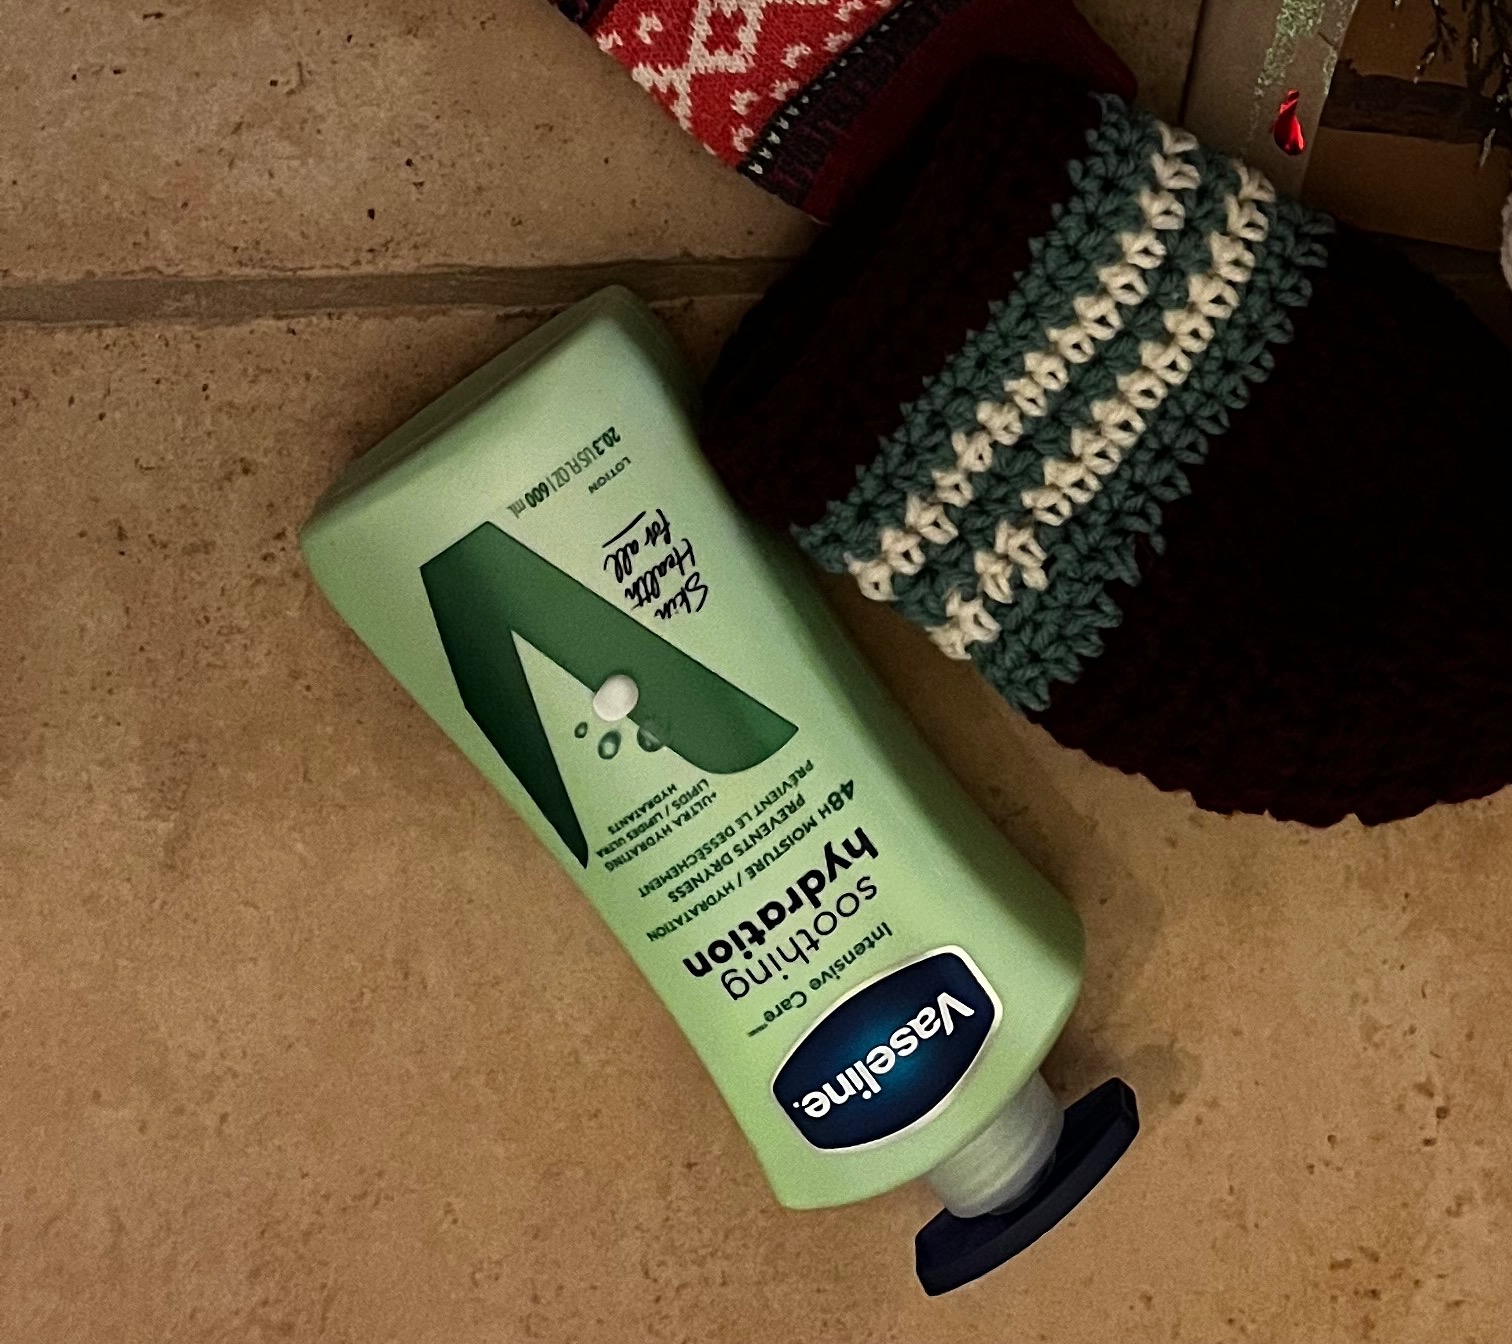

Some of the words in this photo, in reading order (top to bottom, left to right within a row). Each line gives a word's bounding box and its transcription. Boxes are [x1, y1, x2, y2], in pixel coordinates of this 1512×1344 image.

[576, 446, 597, 468] US
[591, 426, 621, 455] 20.3
[524, 481, 549, 507] 600
[550, 466, 570, 488] OZ
[588, 456, 631, 493] LOTION
[638, 511, 676, 552] for
[599, 537, 647, 586] all
[616, 538, 698, 607] Health
[647, 571, 708, 619] Skin
[607, 783, 677, 834] HYDRATANTS
[671, 778, 709, 810] LIPIDS
[753, 759, 813, 816] PRÉVIENT
[812, 777, 859, 821] 48H
[625, 811, 663, 840] LIPIDES
[724, 793, 805, 856] PREVENTS
[734, 811, 753, 829] LE
[595, 836, 626, 858] ULTRA
[604, 824, 672, 871] HYDRATING
[638, 825, 735, 897] DESSÈCHEMENT
[744, 815, 817, 879] MOISTURE
[667, 852, 733, 902] DRYNESS
[646, 882, 734, 941] HYDRATATION
[684, 829, 876, 976] hydration
[718, 876, 876, 998] soothing
[809, 922, 892, 990] Intensive
[763, 990, 807, 1022] Care
